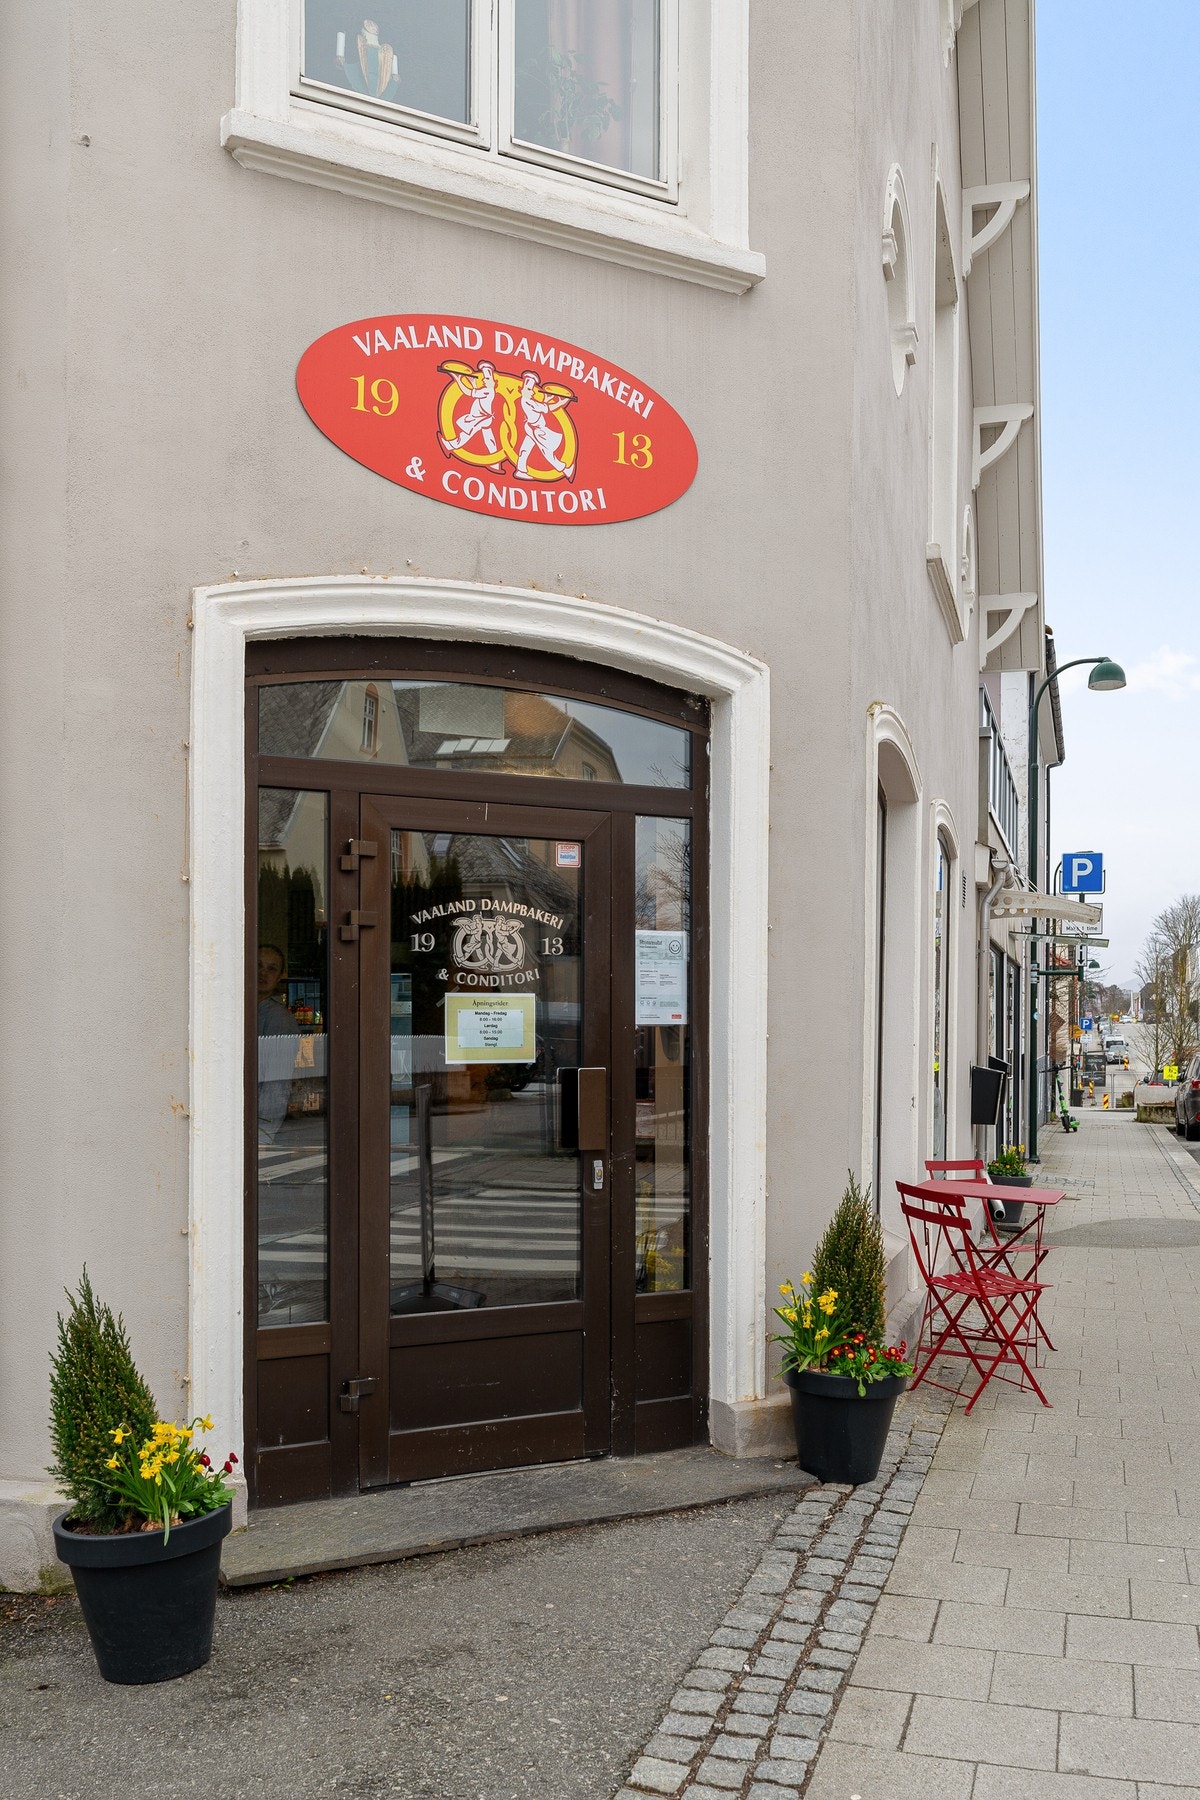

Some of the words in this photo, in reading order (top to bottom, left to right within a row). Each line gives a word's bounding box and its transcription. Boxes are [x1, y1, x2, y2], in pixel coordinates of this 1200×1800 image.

[352, 325, 483, 357] VAALAND
[494, 330, 655, 420] DAMPBAKERI
[350, 374, 399, 417] 19
[612, 430, 654, 469] 13
[405, 456, 426, 482] &
[441, 470, 607, 514] CONDITORI
[1072, 857, 1093, 888] P
[412, 900, 476, 925] VAALAND
[482, 899, 564, 930] DAMPBAKERI
[410, 932, 436, 953] 19
[541, 937, 564, 956] 13
[438, 968, 450, 981] &
[456, 967, 540, 987] CONDITORI
[1082, 1019, 1090, 1029] P
